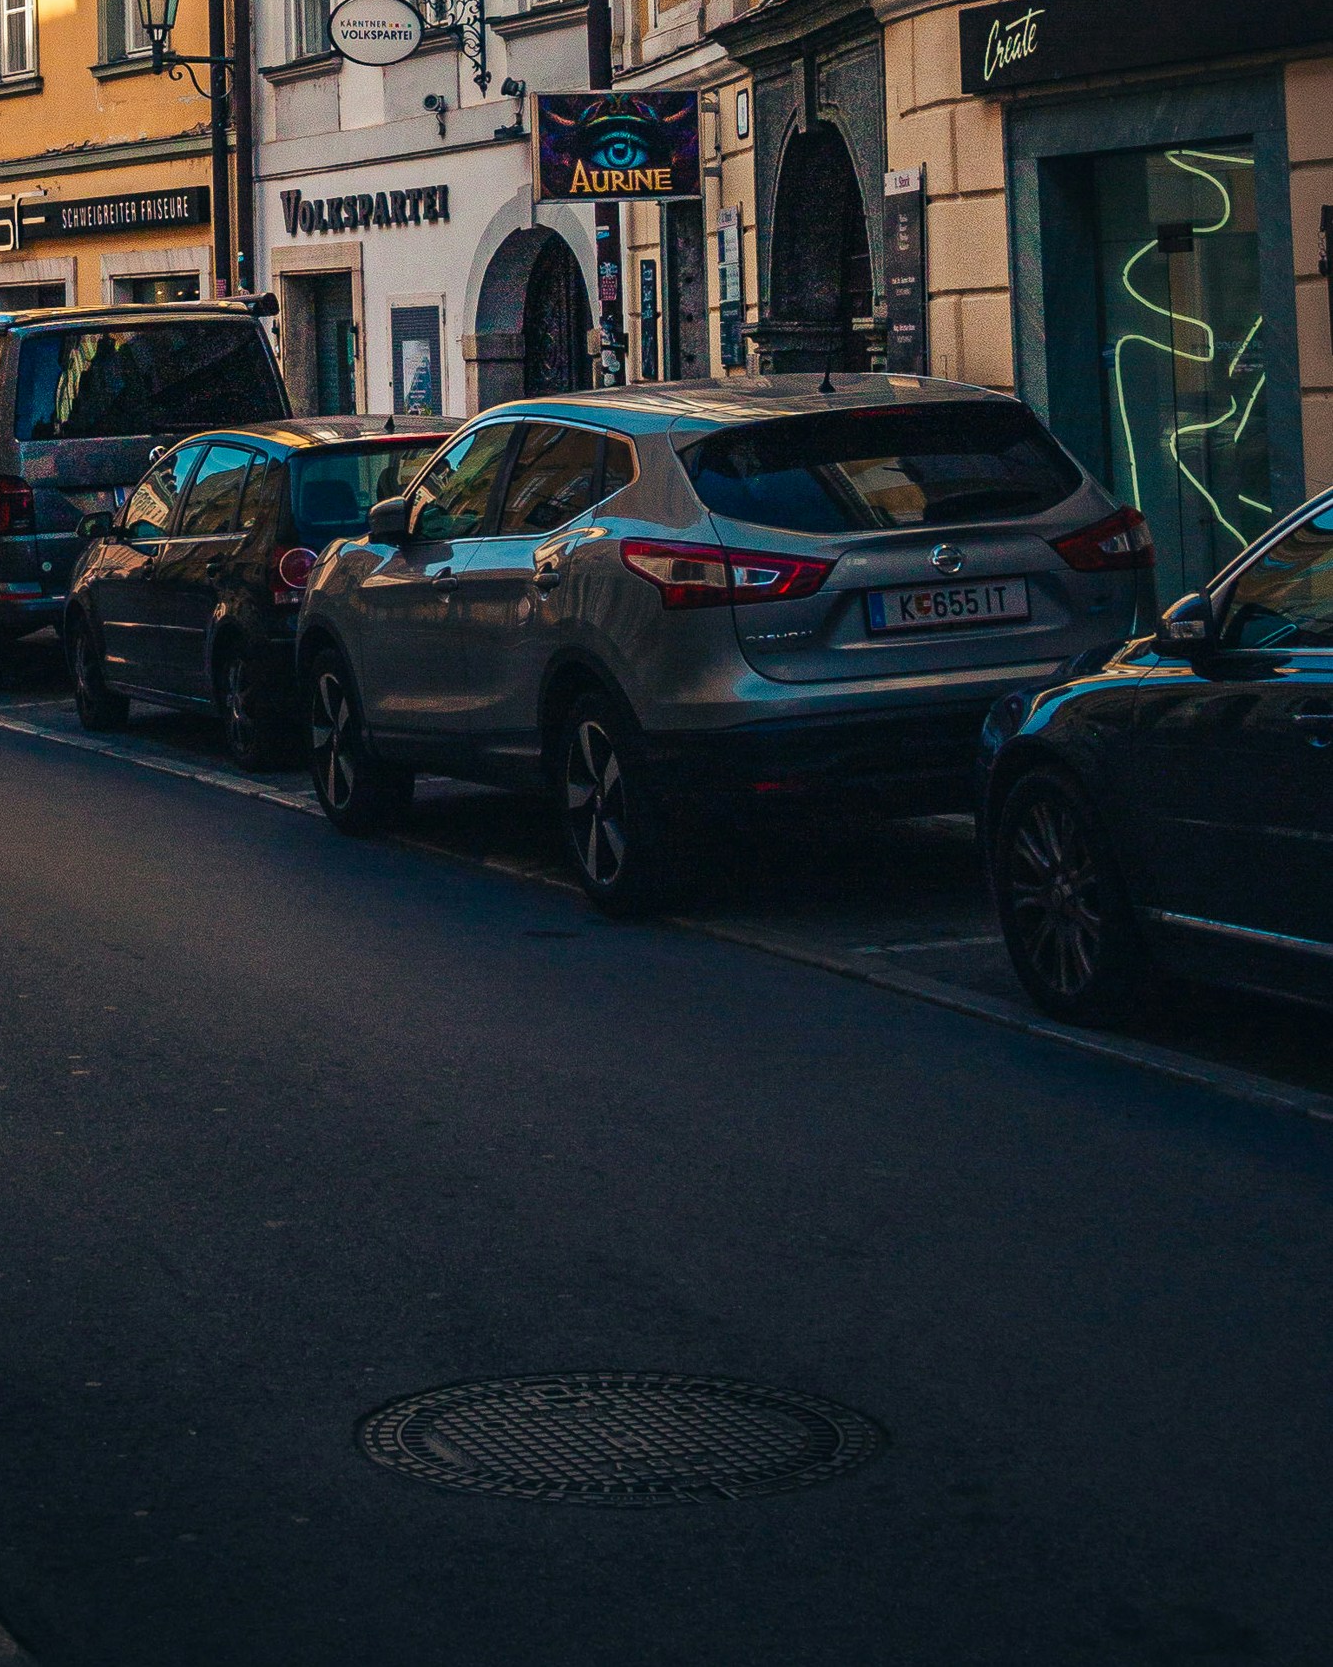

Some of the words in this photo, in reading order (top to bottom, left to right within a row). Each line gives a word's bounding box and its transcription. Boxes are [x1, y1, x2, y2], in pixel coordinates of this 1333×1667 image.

[340, 20, 387, 28] KÄRNTNER
[341, 30, 412, 41] VOLKSPARTEI
[984, 8, 1046, 81] Create
[569, 158, 673, 193] AURINE
[61, 201, 137, 229] SCHWEIGREITER
[140, 195, 189, 221] FRISEURE
[279, 185, 450, 236] VOLKSPARTEI
